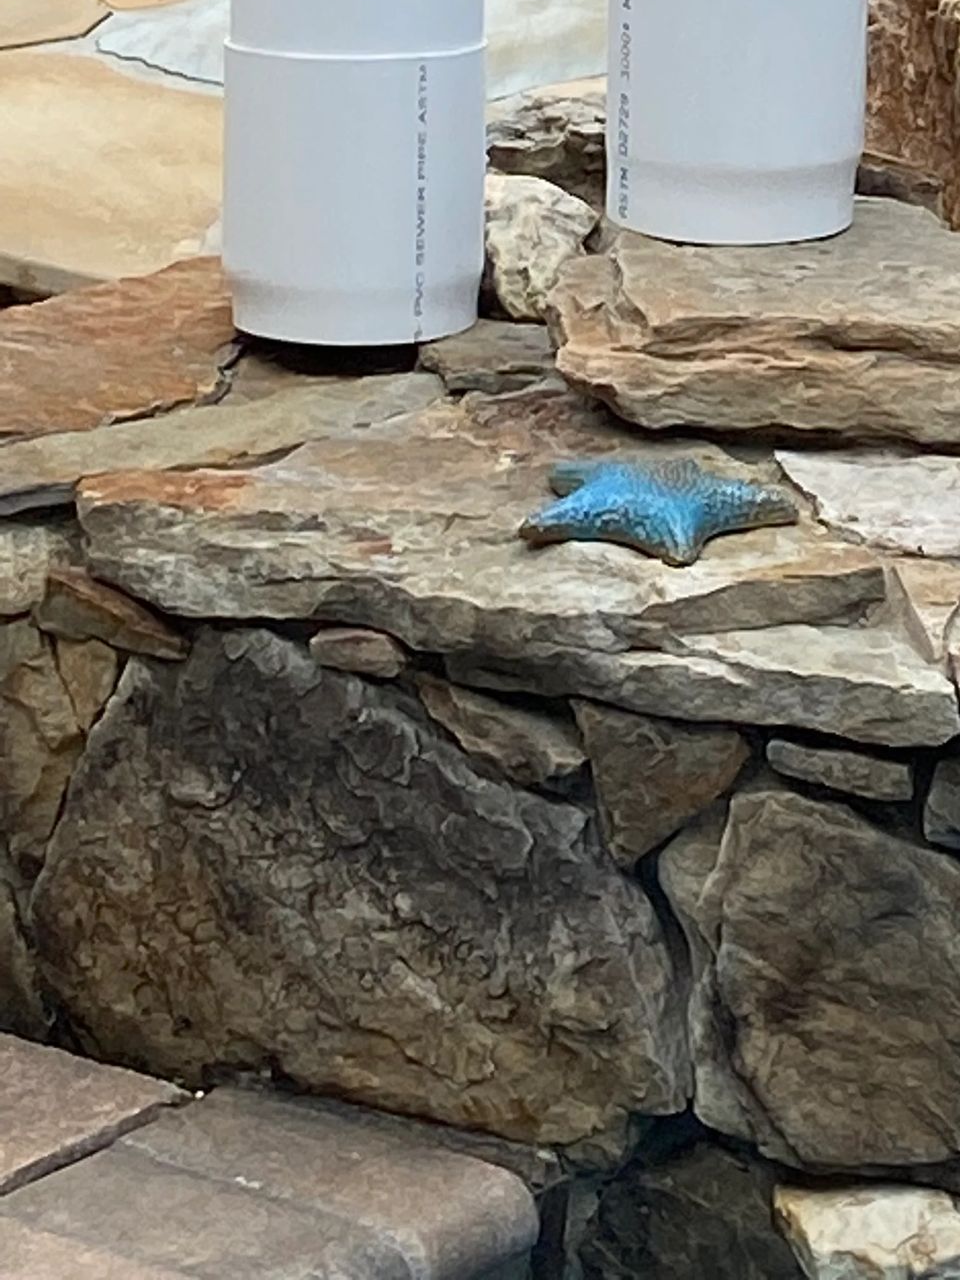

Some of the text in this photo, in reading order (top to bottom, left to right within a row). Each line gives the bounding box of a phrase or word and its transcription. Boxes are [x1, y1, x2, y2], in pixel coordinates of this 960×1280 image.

[416, 64, 427, 125] ASTM
[416, 131, 427, 180] PIPE
[415, 187, 425, 266] SEWER
